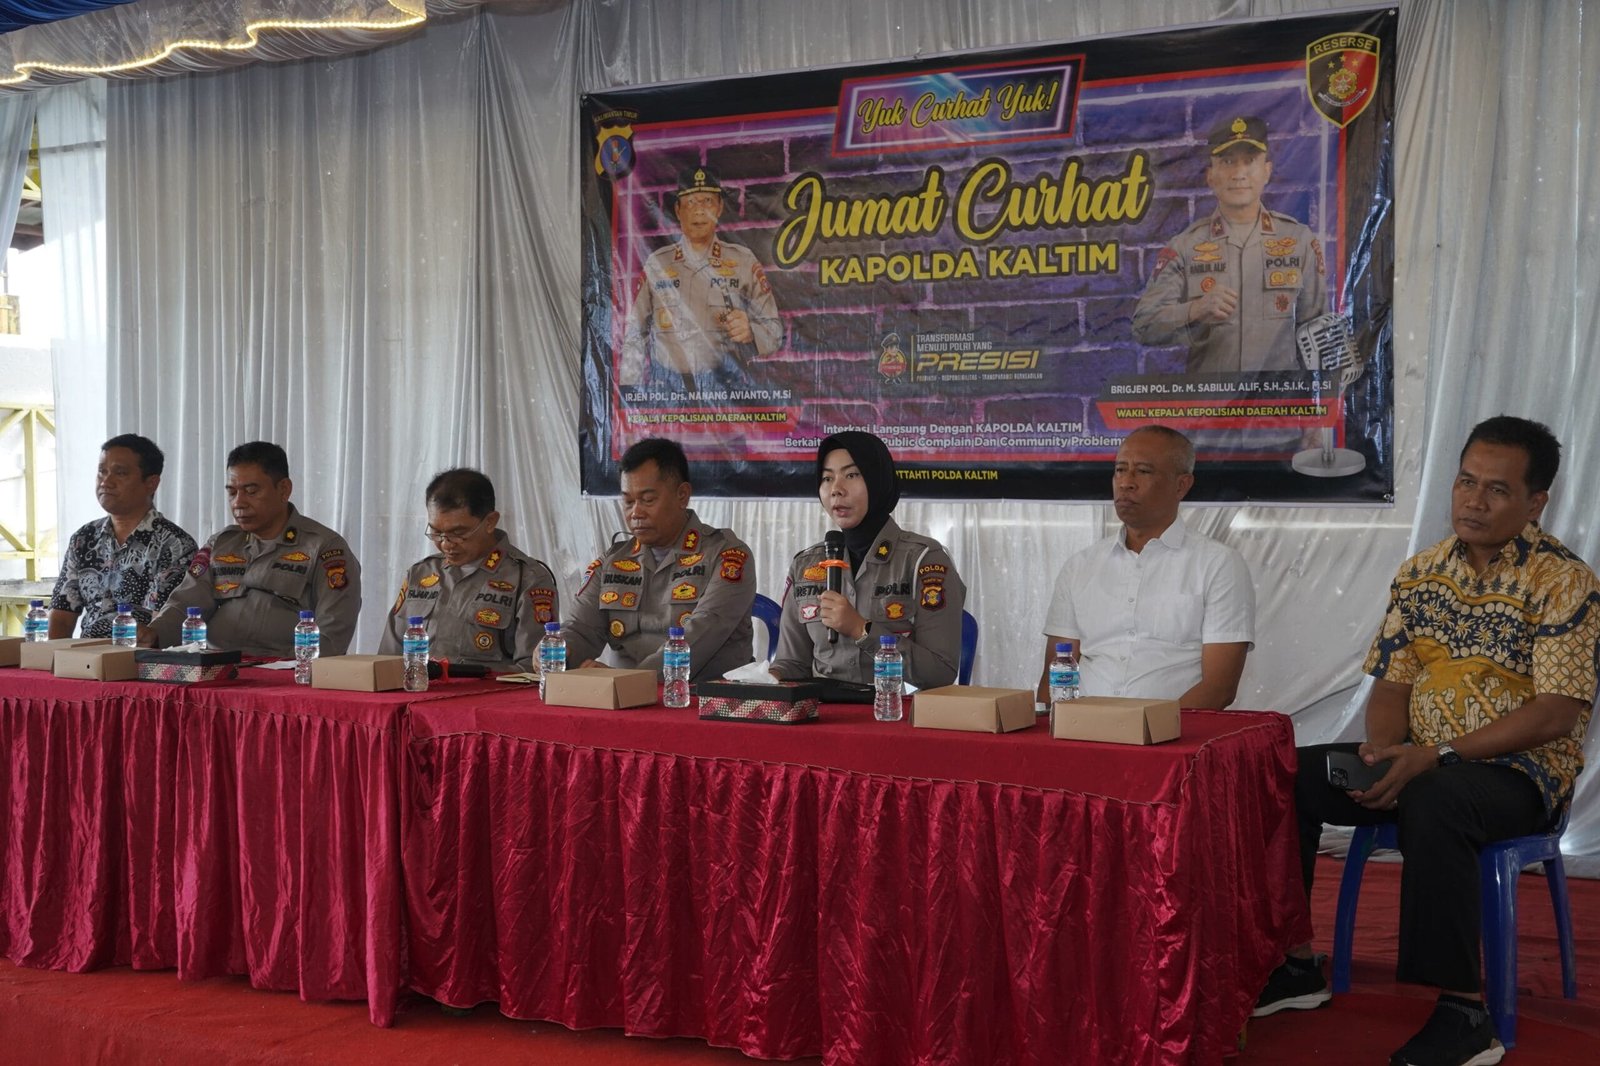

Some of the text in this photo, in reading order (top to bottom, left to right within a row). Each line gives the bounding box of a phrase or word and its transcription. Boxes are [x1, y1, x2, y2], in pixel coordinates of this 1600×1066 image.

[1313, 37, 1373, 54] RESERSE
[857, 81, 1059, 134] Yuk Curhat Yuk!
[775, 153, 1150, 265] Jumat Curhat
[820, 243, 1117, 285] KAPOLDA KALTIM
[1266, 257, 1300, 268] POLRI
[915, 333, 975, 343] TRANSFORMASI
[916, 341, 993, 352] MENUJU POLRI YANG
[916, 350, 1040, 372] PRESISI
[1110, 385, 1149, 394] BRIGJEN
[1150, 384, 1170, 393] POL.
[1172, 384, 1184, 393] Dr.
[1186, 384, 1196, 393] M.
[1197, 383, 1236, 392] SABILUL
[1238, 382, 1262, 393] ALIF,
[625, 392, 648, 402] IRJEN
[670, 392, 687, 401] Drs.
[688, 391, 728, 401] NANANG
[729, 390, 771, 401] AVIANTO,
[772, 389, 792, 400] M.Si
[661, 413, 714, 423] KEPOLISIAN
[715, 413, 753, 422] DAERAH
[754, 413, 787, 422] KALTIM
[1116, 406, 1328, 418] WAKIL KEPALA KEPOLISIAN DAERAH KALTIM
[872, 424, 926, 436] Langsung
[929, 423, 973, 435] Dengan
[975, 422, 1034, 433] KAPOLDA
[1037, 422, 1083, 433] KALTIM
[785, 437, 823, 447] Berkait
[918, 437, 971, 449] Complain
[974, 437, 997, 447] Dan
[999, 436, 1068, 448] Community
[931, 470, 962, 480] POLDA
[964, 470, 998, 480] KALTIM
[271, 562, 309, 576] POLRI
[671, 565, 706, 582] POLRI
[796, 584, 827, 598] RETN
[874, 583, 912, 597] POLRI
[475, 592, 514, 608] POLRI
